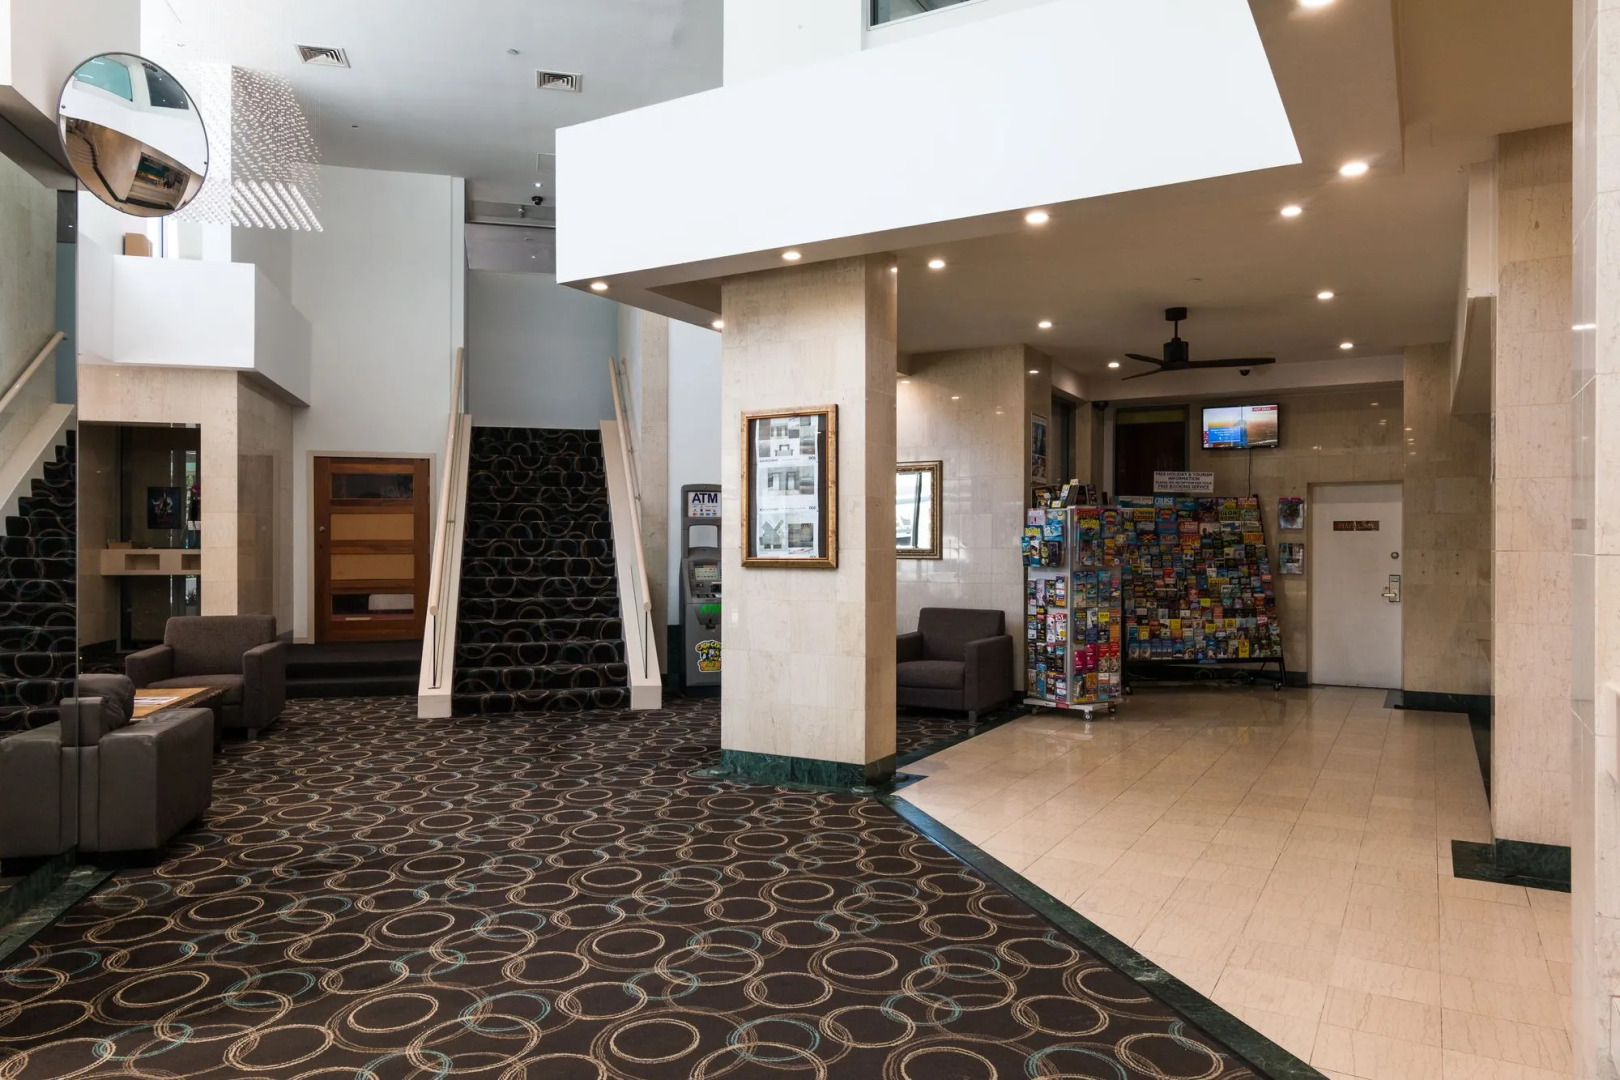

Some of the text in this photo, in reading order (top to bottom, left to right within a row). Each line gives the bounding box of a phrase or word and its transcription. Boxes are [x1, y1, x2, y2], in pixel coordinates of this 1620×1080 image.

[692, 493, 718, 504] ATM
[1155, 498, 1173, 506] CRUISE
[700, 604, 721, 614] ATM
